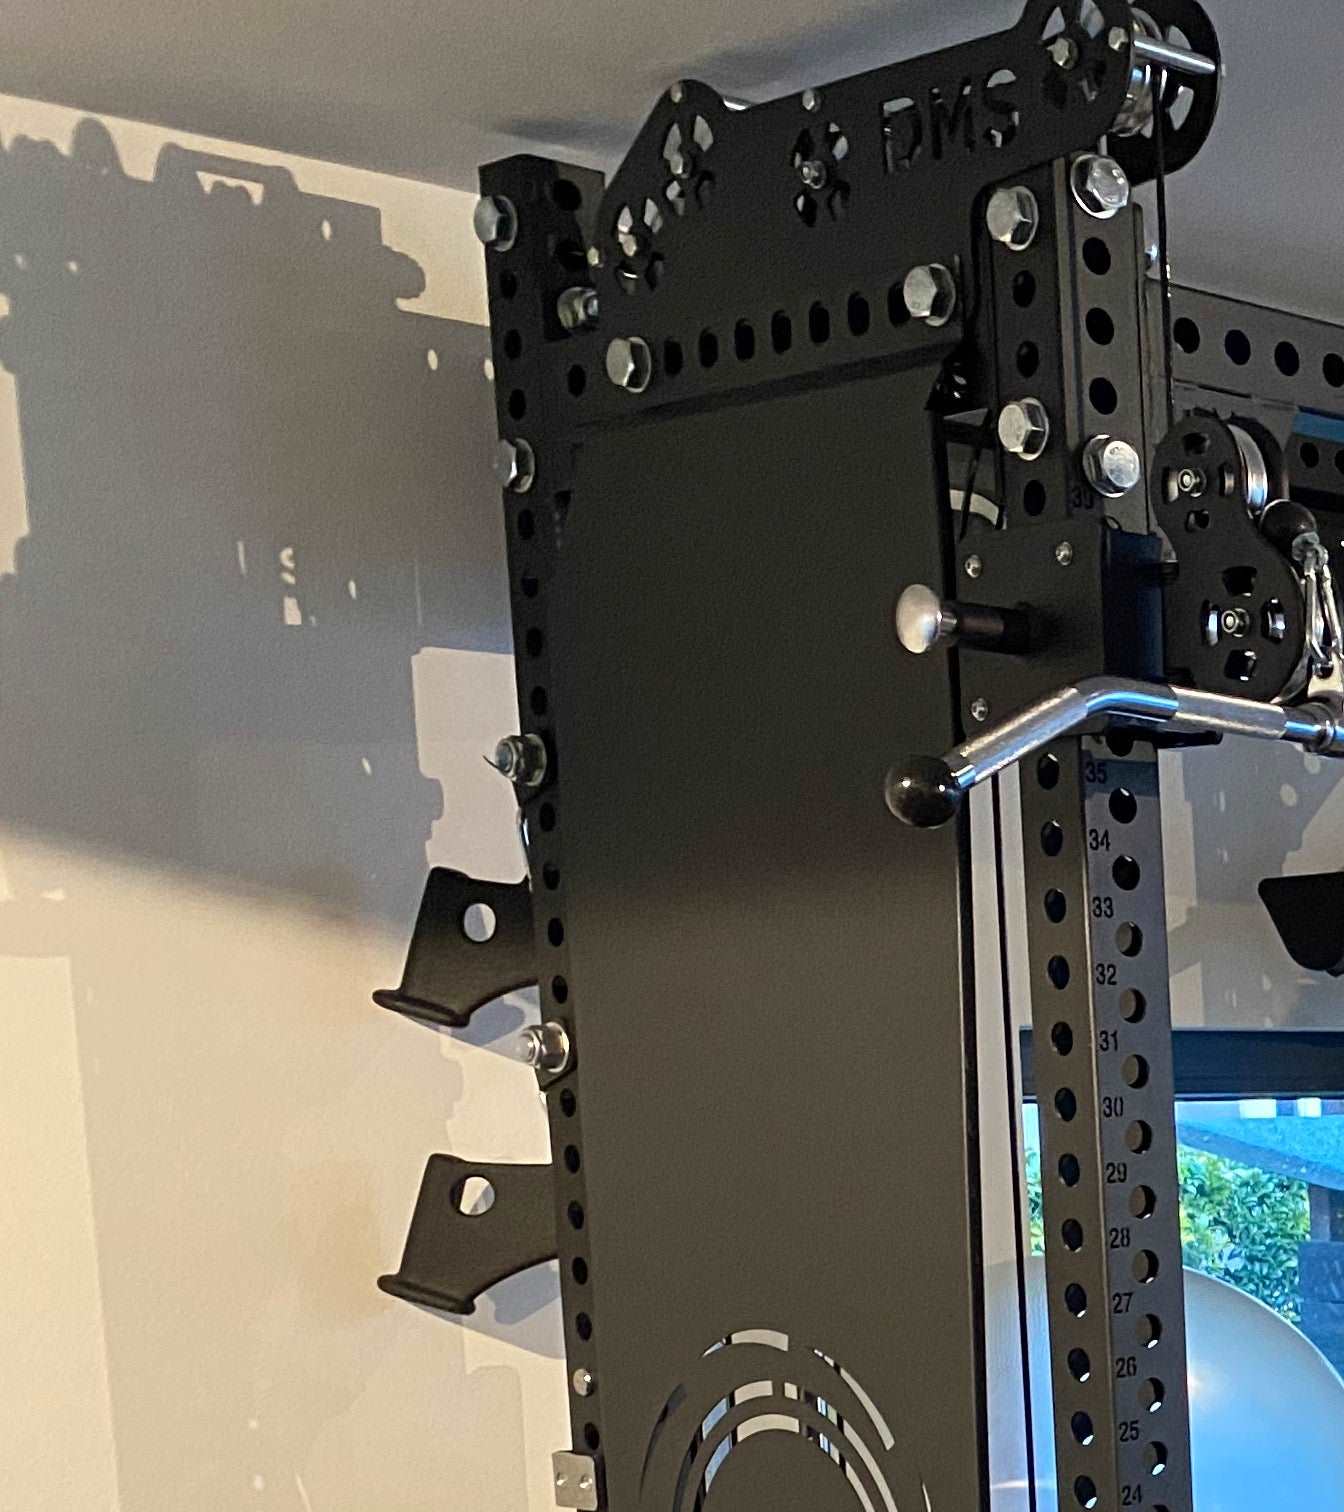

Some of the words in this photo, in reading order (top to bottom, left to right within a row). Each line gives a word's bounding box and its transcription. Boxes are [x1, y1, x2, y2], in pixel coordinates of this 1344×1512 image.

[880, 68, 1020, 175] DMS
[1085, 763, 1107, 783] 35
[1089, 830, 1110, 850] 34
[1092, 897, 1114, 918] 33
[1095, 964, 1117, 985] 32
[1099, 1030, 1119, 1051] 31
[1103, 1097, 1124, 1118] 30
[1106, 1163, 1127, 1183] 29
[1110, 1228, 1131, 1248] 28
[1112, 1293, 1133, 1313] 27
[1116, 1357, 1137, 1378] 26
[1119, 1421, 1140, 1441] 25
[1122, 1485, 1142, 1505] 24
